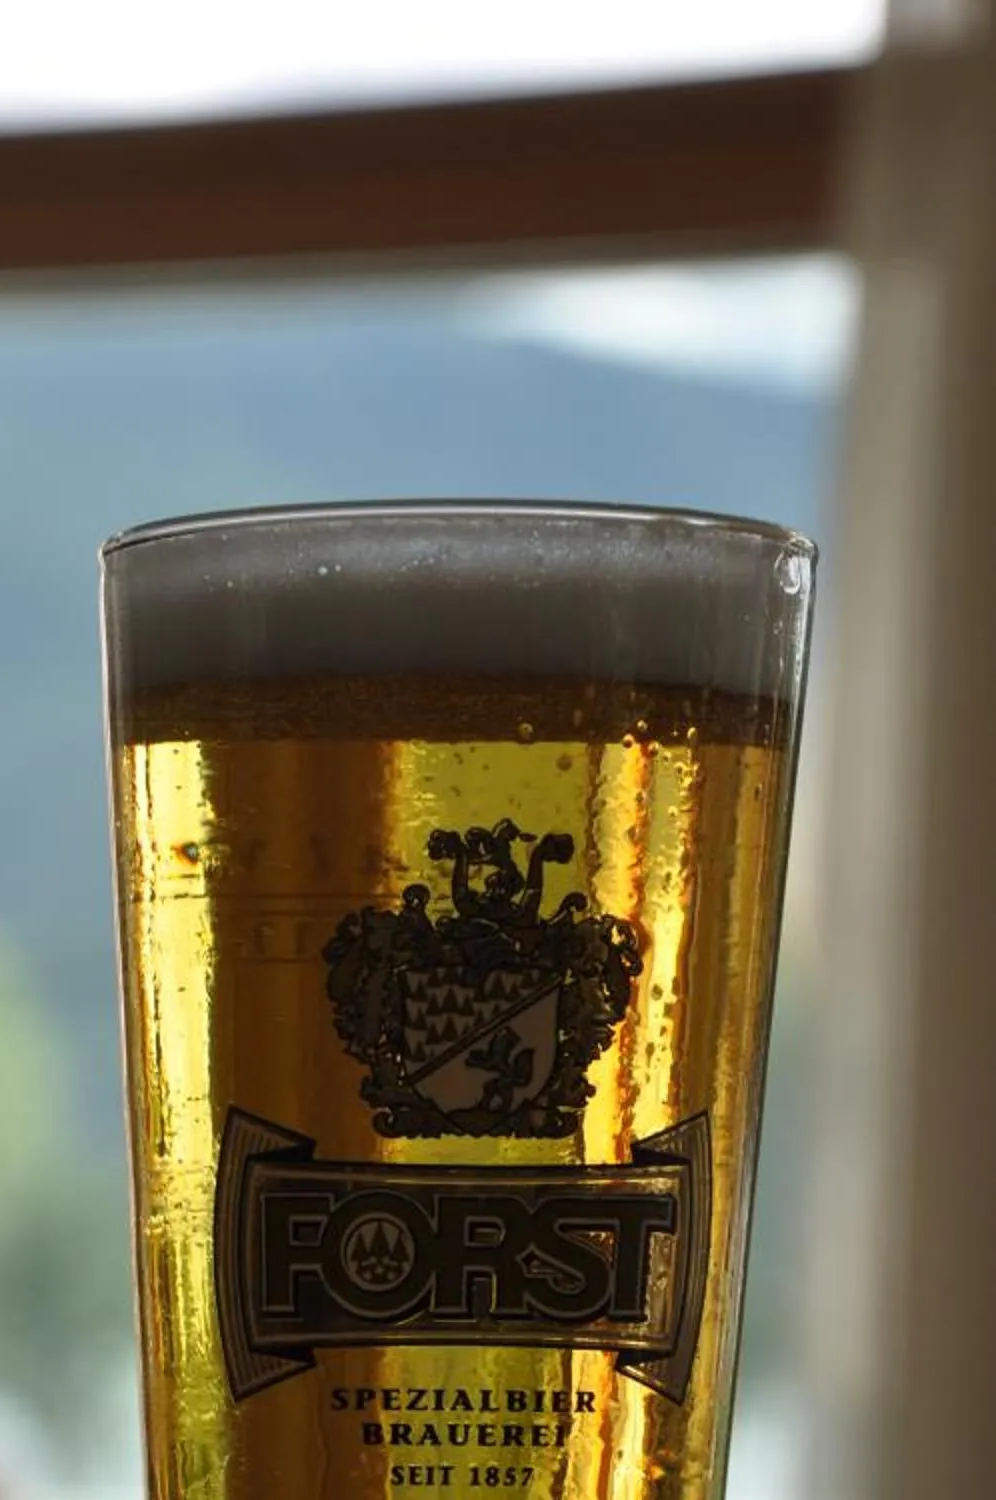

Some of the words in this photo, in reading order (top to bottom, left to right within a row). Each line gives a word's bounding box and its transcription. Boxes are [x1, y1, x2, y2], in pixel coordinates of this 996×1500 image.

[261, 1189, 674, 1323] FORST
[331, 1387, 596, 1414] SPEZIALBIER
[362, 1423, 567, 1448] BRAUEREI
[390, 1465, 453, 1487] SEIT
[470, 1465, 535, 1487] 1857
